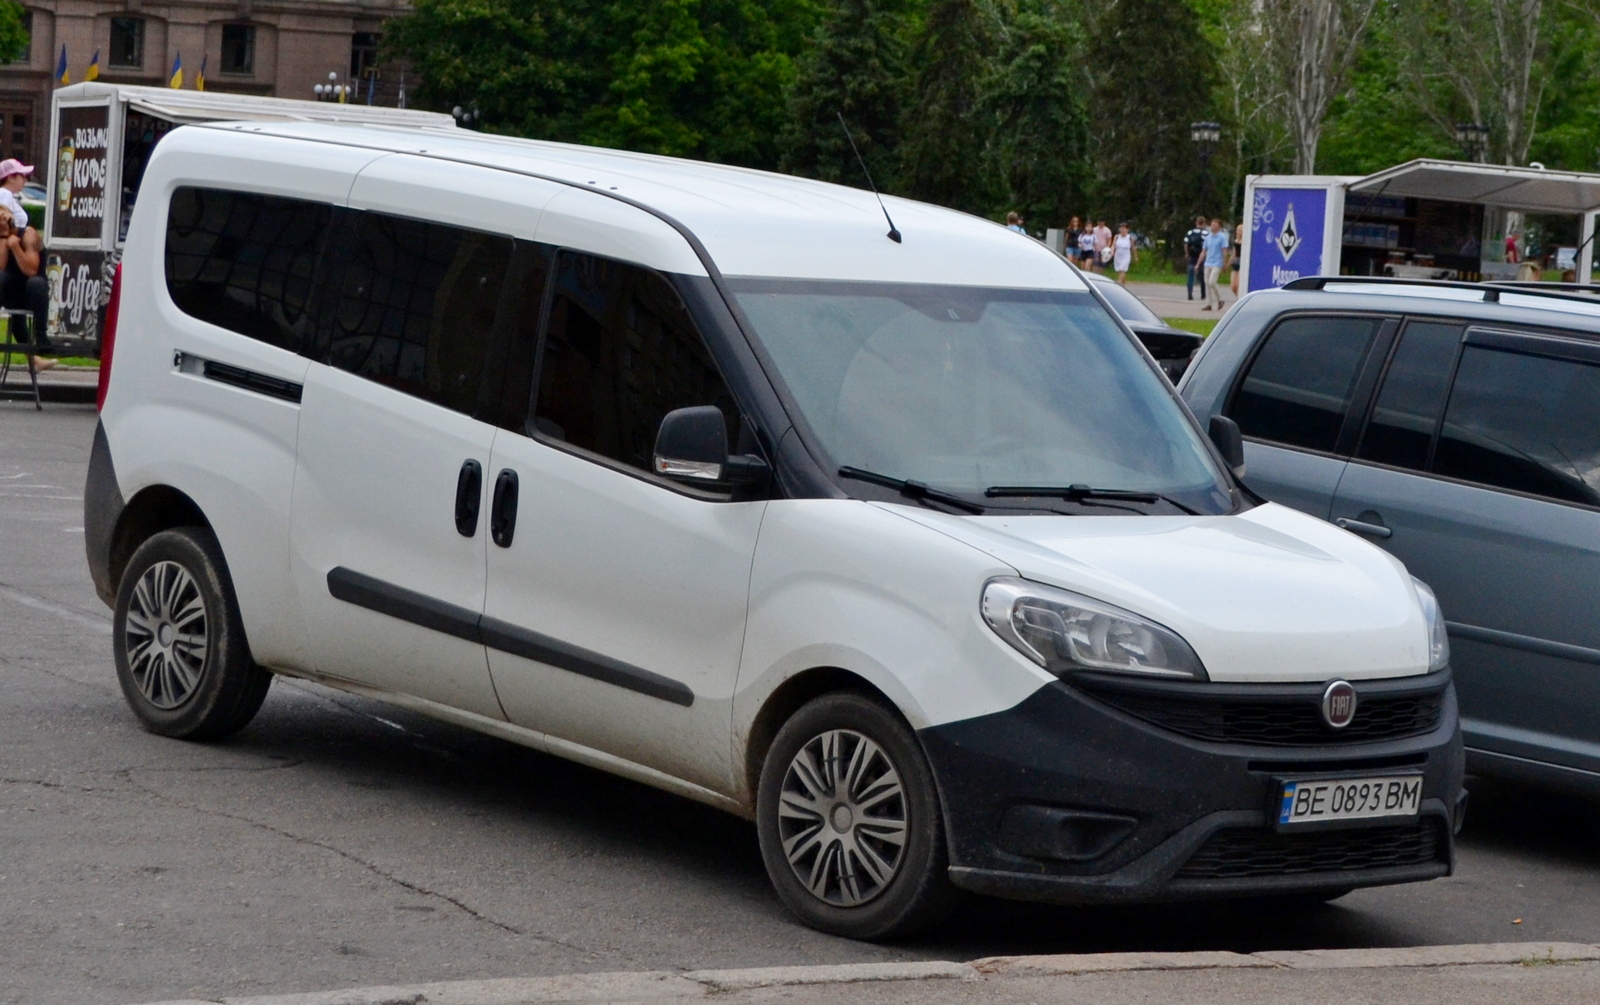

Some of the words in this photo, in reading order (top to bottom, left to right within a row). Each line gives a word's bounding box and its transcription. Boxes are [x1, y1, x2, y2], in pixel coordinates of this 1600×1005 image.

[75, 127, 109, 149] ВОЗЬМИ
[74, 157, 106, 188] КОФЕ
[60, 263, 100, 325] Coffee
[1331, 696, 1351, 716] FIAT
[1294, 786, 1328, 816] BE
[1331, 783, 1383, 813] 0893
[1385, 781, 1420, 810] BM
